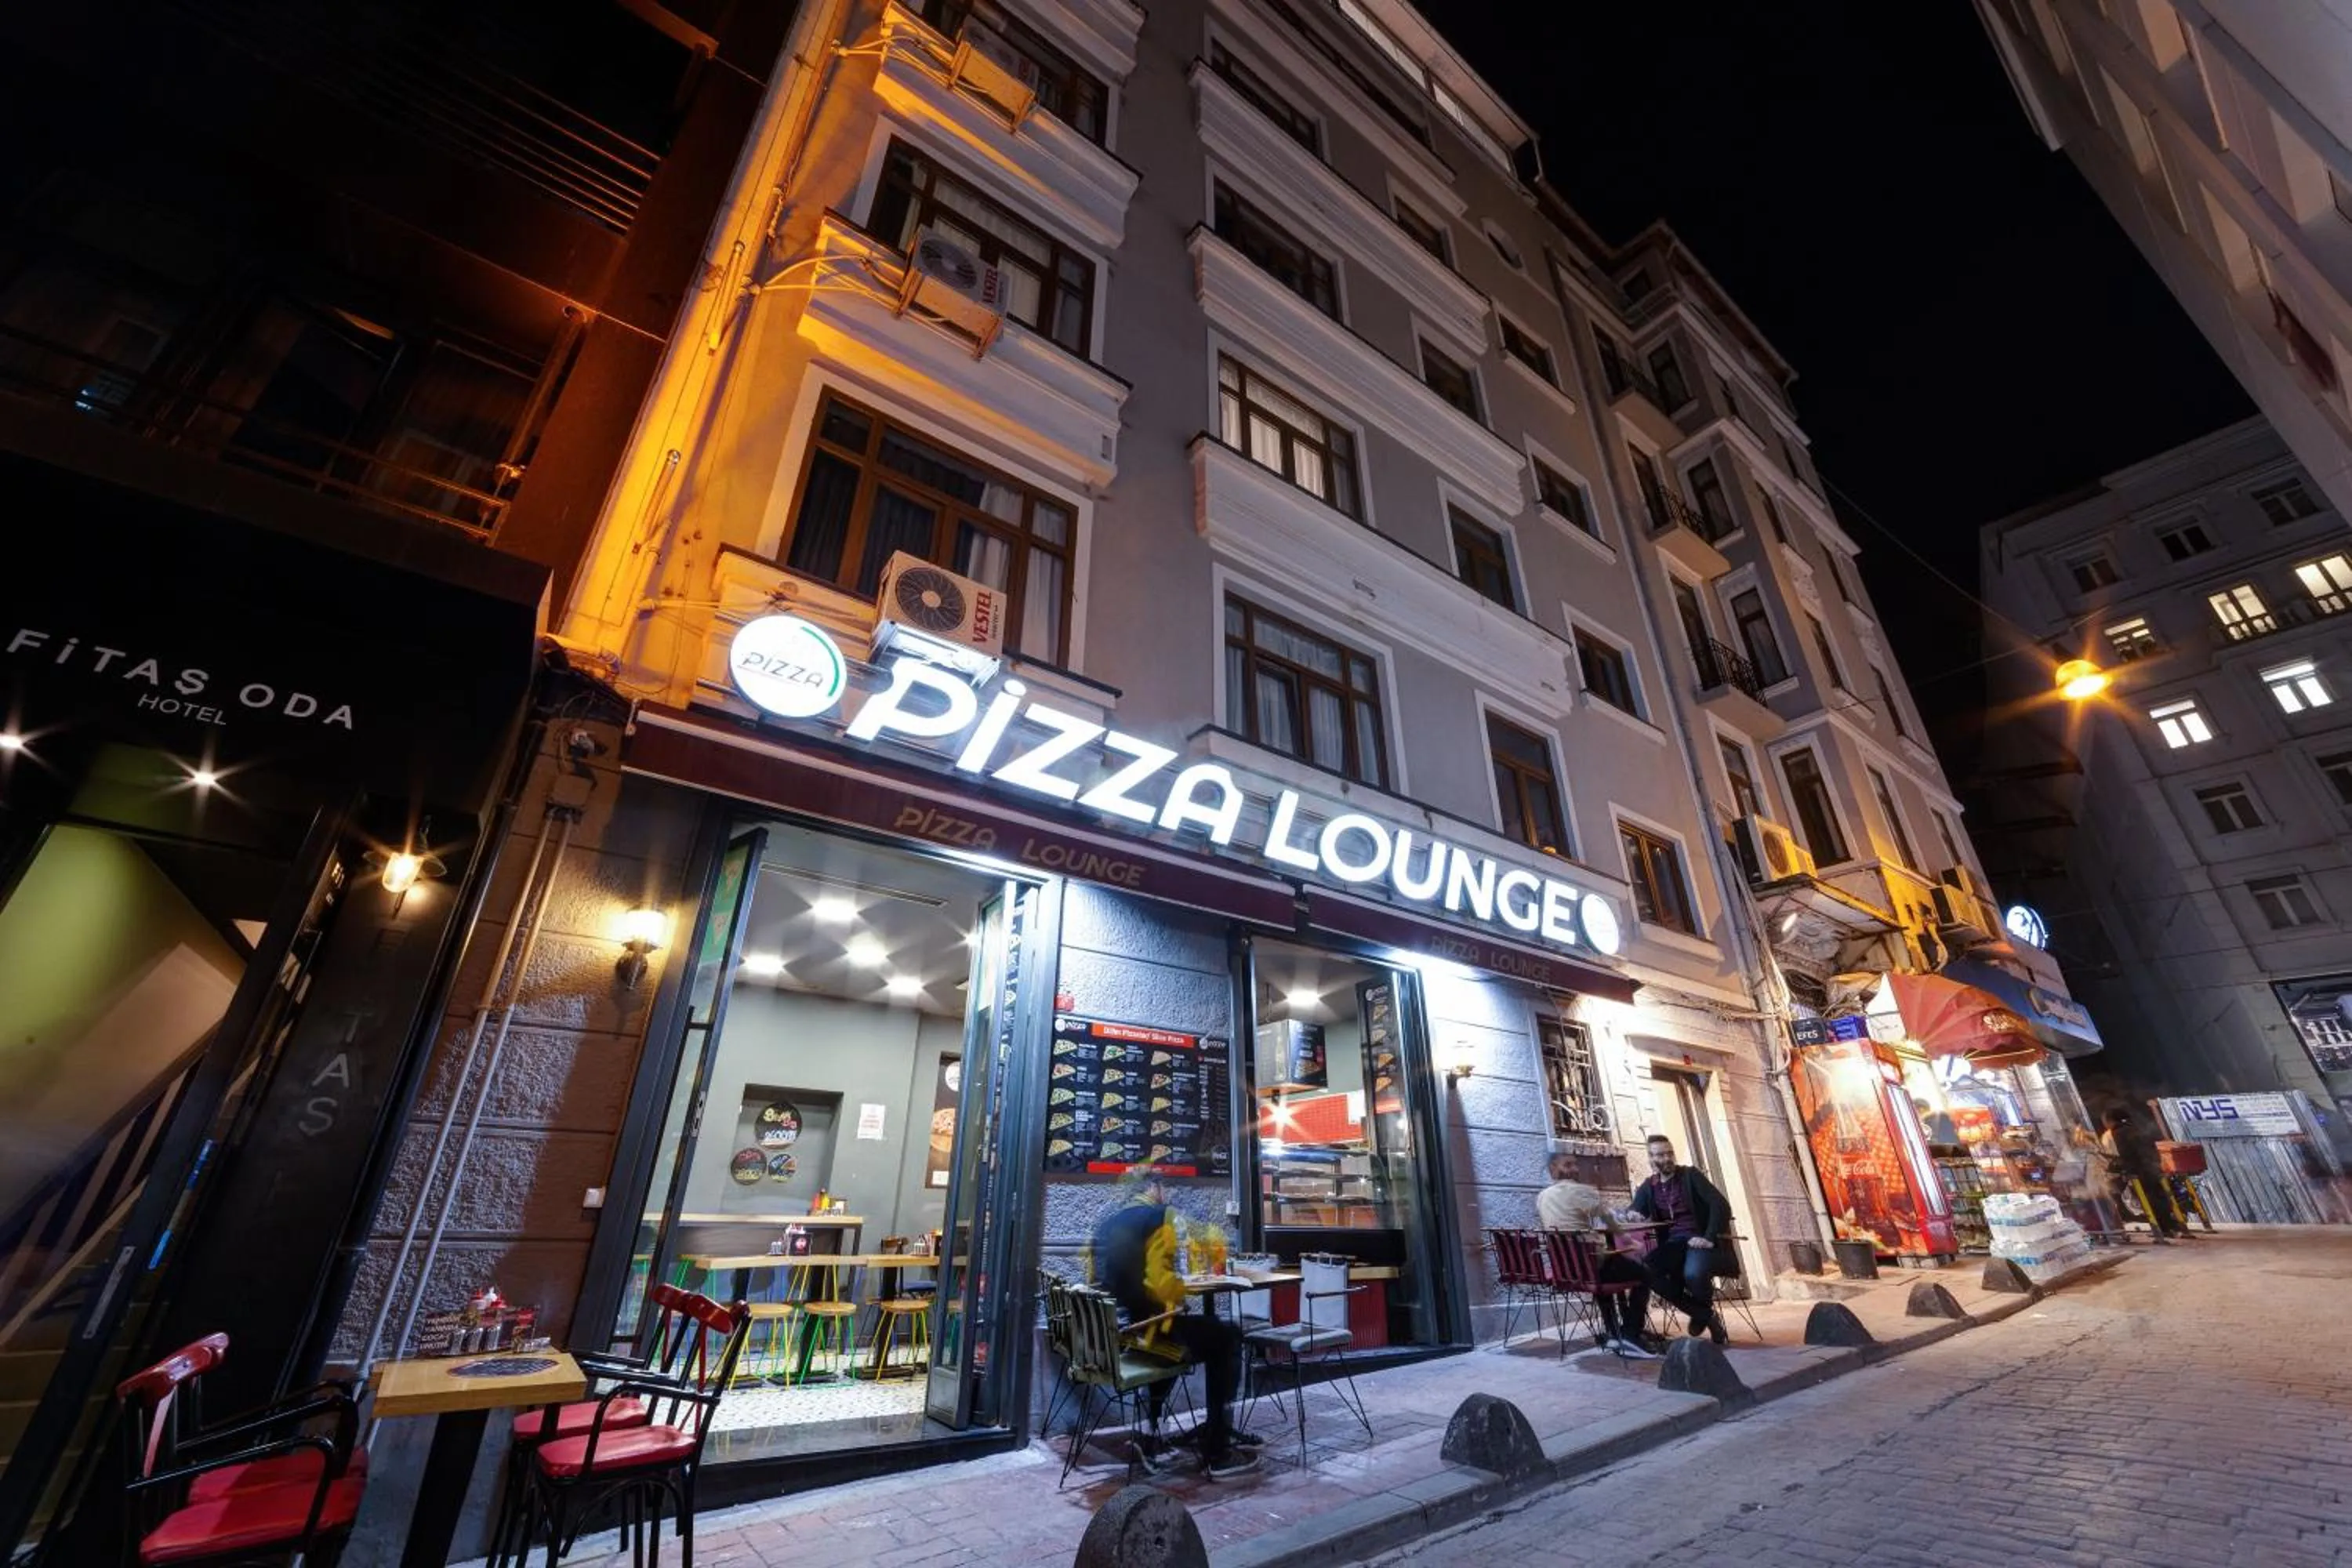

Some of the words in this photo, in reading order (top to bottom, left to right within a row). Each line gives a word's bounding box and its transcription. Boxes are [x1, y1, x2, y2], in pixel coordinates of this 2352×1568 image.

[972, 591, 992, 642] VESTEL
[138, 693, 227, 725] HOTEL
[239, 684, 352, 730] ODA
[1021, 838, 1146, 887] LOUNGE
[1264, 791, 1577, 946] LOUNGE
[1490, 952, 1551, 980] LOUNGE
[2179, 1098, 2240, 1121] NYS
